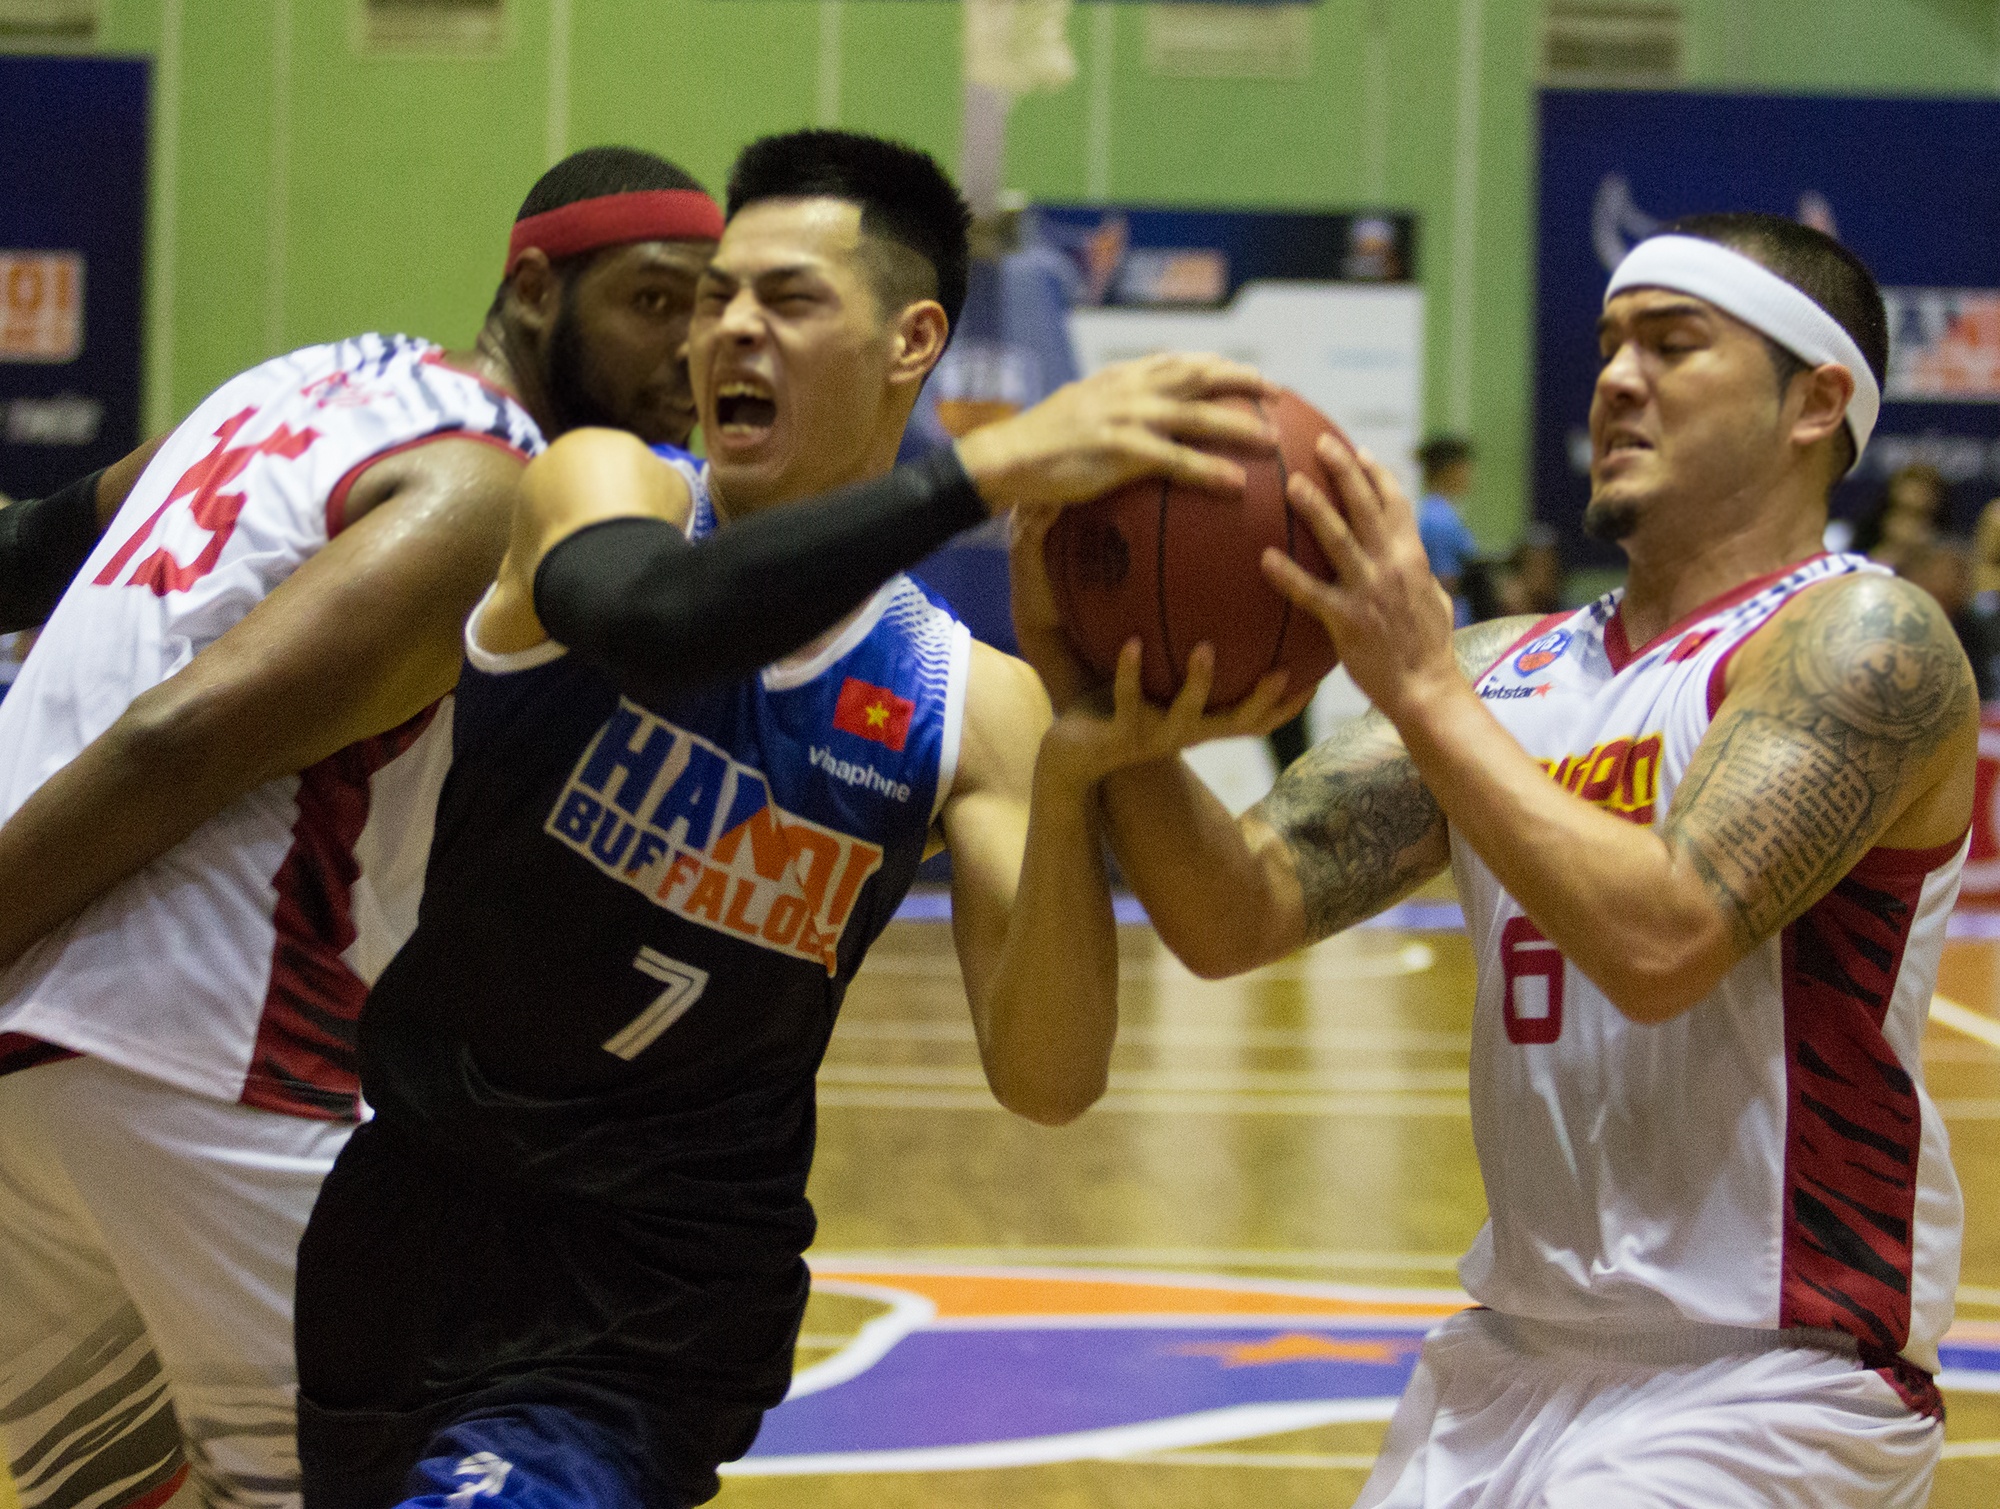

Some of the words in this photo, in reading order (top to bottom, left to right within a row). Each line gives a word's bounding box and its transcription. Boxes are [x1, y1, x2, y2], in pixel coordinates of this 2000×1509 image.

[91, 405, 322, 598] 15
[809, 745, 911, 803] vinaphne
[601, 945, 709, 1061] 7
[1501, 916, 1566, 1045] 6
